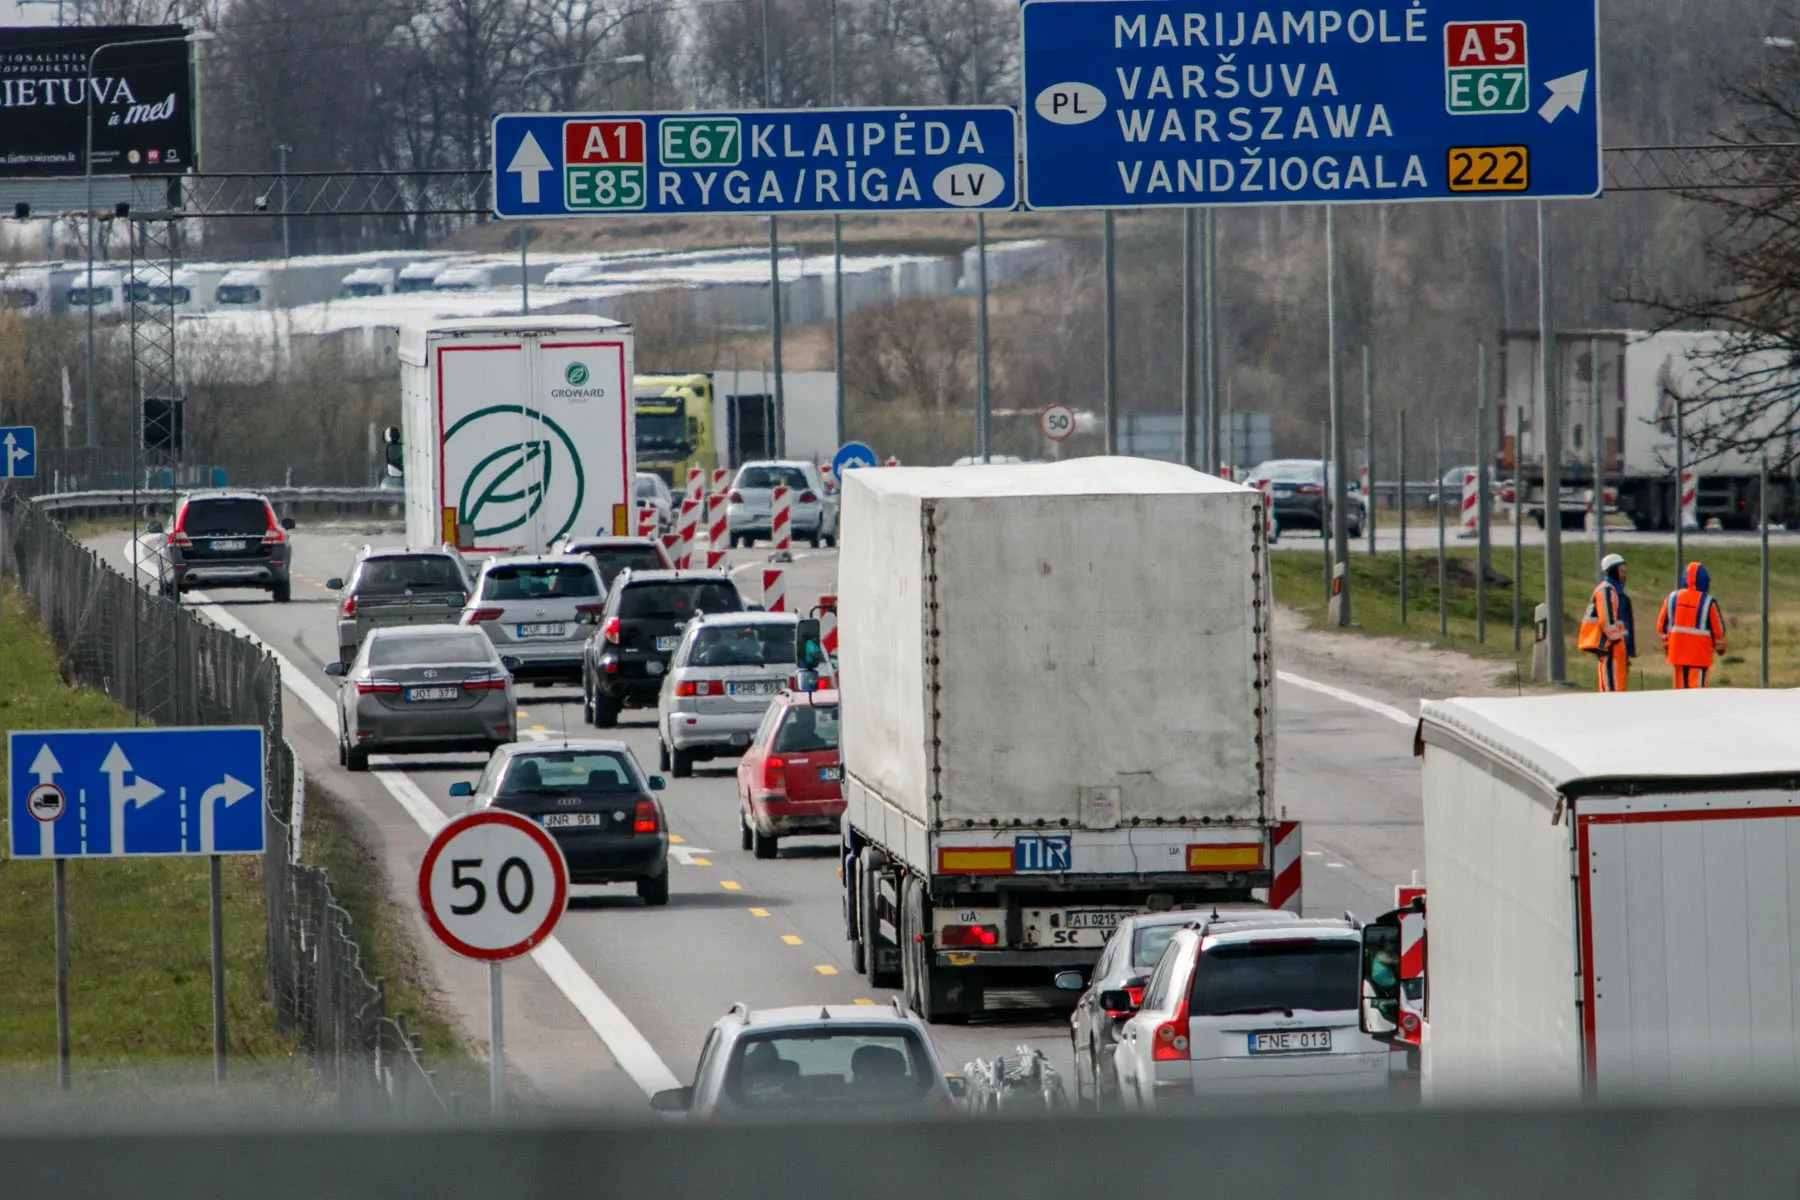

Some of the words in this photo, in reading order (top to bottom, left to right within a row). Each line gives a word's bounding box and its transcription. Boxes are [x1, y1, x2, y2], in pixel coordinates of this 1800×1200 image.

[1114, 0, 1428, 48] MARIJAMPOLĖ
[1459, 27, 1517, 61] A5
[0, 77, 136, 107] IETUVA
[1115, 53, 1339, 100] VARŠUVA
[1450, 72, 1524, 107] E67
[123, 93, 175, 124] mes
[1052, 93, 1087, 115] PL
[752, 112, 986, 158] KLAIPĖDA
[1116, 104, 1394, 143] WARSZAWA
[582, 124, 628, 160] A1
[664, 125, 738, 160] E67
[659, 161, 922, 206] RYGA/RĪGA
[1117, 146, 1428, 194] VANDŽIOGALA
[1452, 151, 1526, 186] 222
[568, 169, 642, 206] E85
[950, 173, 985, 197] LV
[551, 388, 605, 398] GROWARD
[1048, 414, 1069, 430] 50
[413, 688, 432, 699] JOT
[439, 687, 457, 698] 377
[736, 683, 757, 694] CHR
[545, 814, 570, 827] JNR
[1018, 838, 1068, 869] TIR
[449, 856, 534, 917] 50
[961, 911, 977, 922] UA
[1091, 913, 1117, 927] 0215
[1054, 930, 1079, 944] SC
[1258, 1033, 1290, 1049] FNE
[1300, 1032, 1329, 1048] 013
